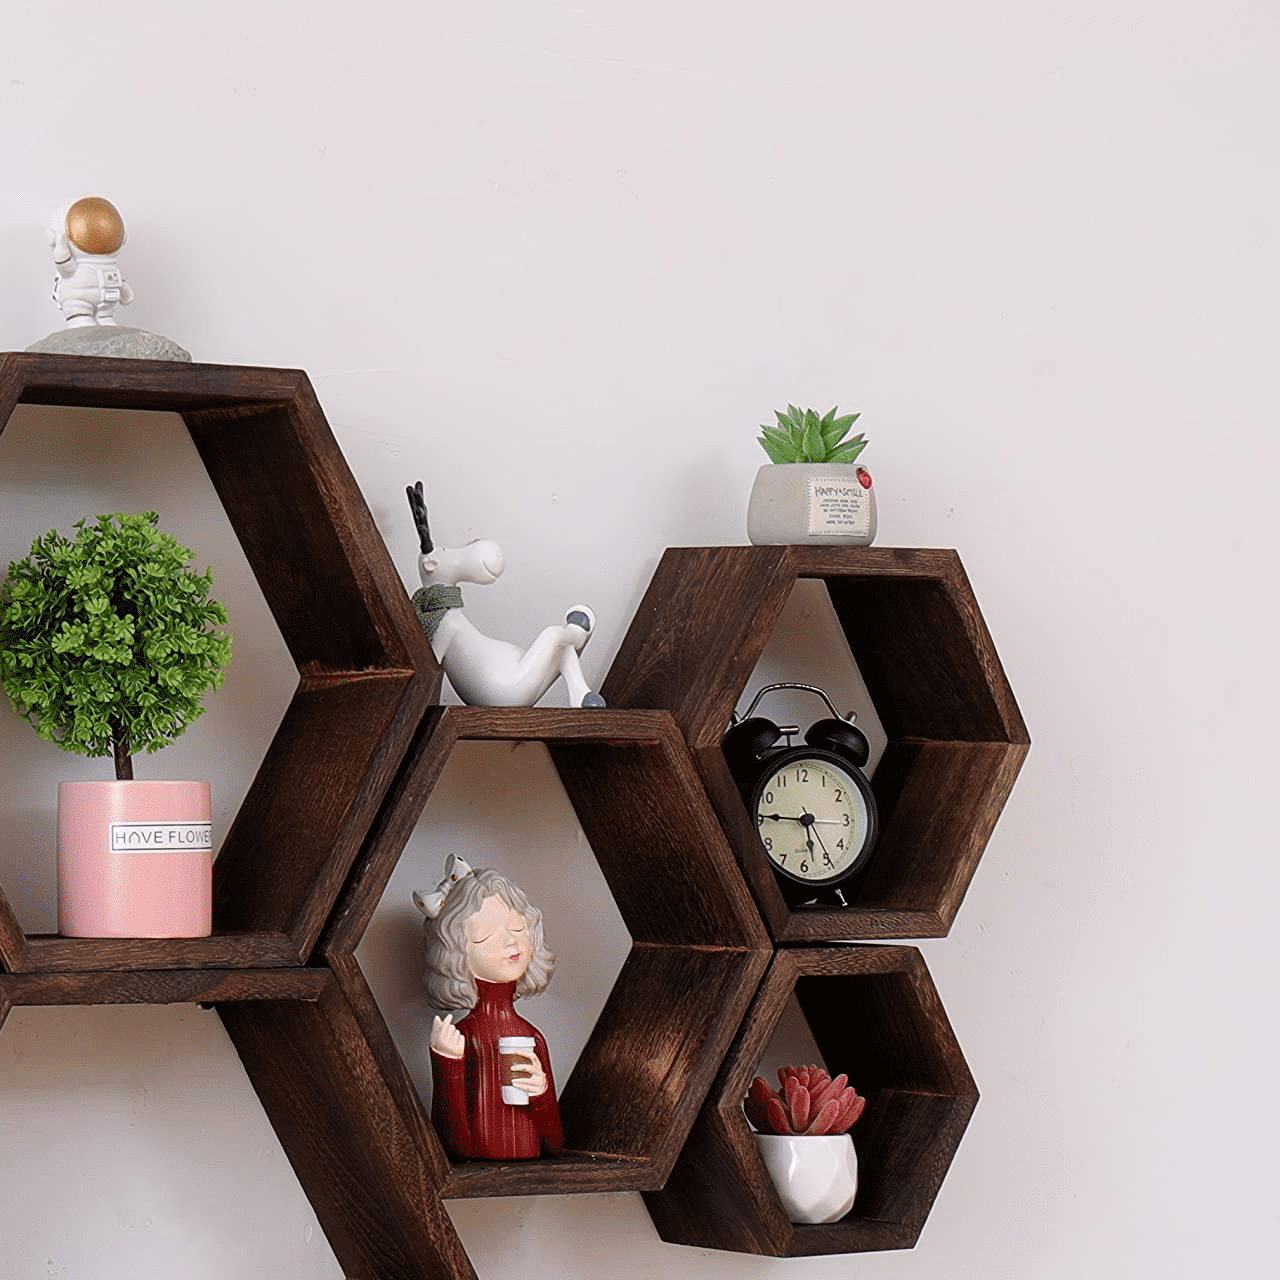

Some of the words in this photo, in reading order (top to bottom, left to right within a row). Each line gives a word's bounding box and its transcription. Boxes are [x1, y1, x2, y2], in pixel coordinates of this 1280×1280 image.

[777, 775, 786, 787] 11
[796, 769, 809, 782] 12
[822, 775, 826, 787] 1
[834, 789, 842, 802] 2
[842, 813, 850, 827] 3
[116, 831, 163, 844] HAVE
[764, 837, 773, 851] 8
[836, 837, 844, 850] 4
[779, 853, 787, 866] 7
[800, 859, 809, 873] 6
